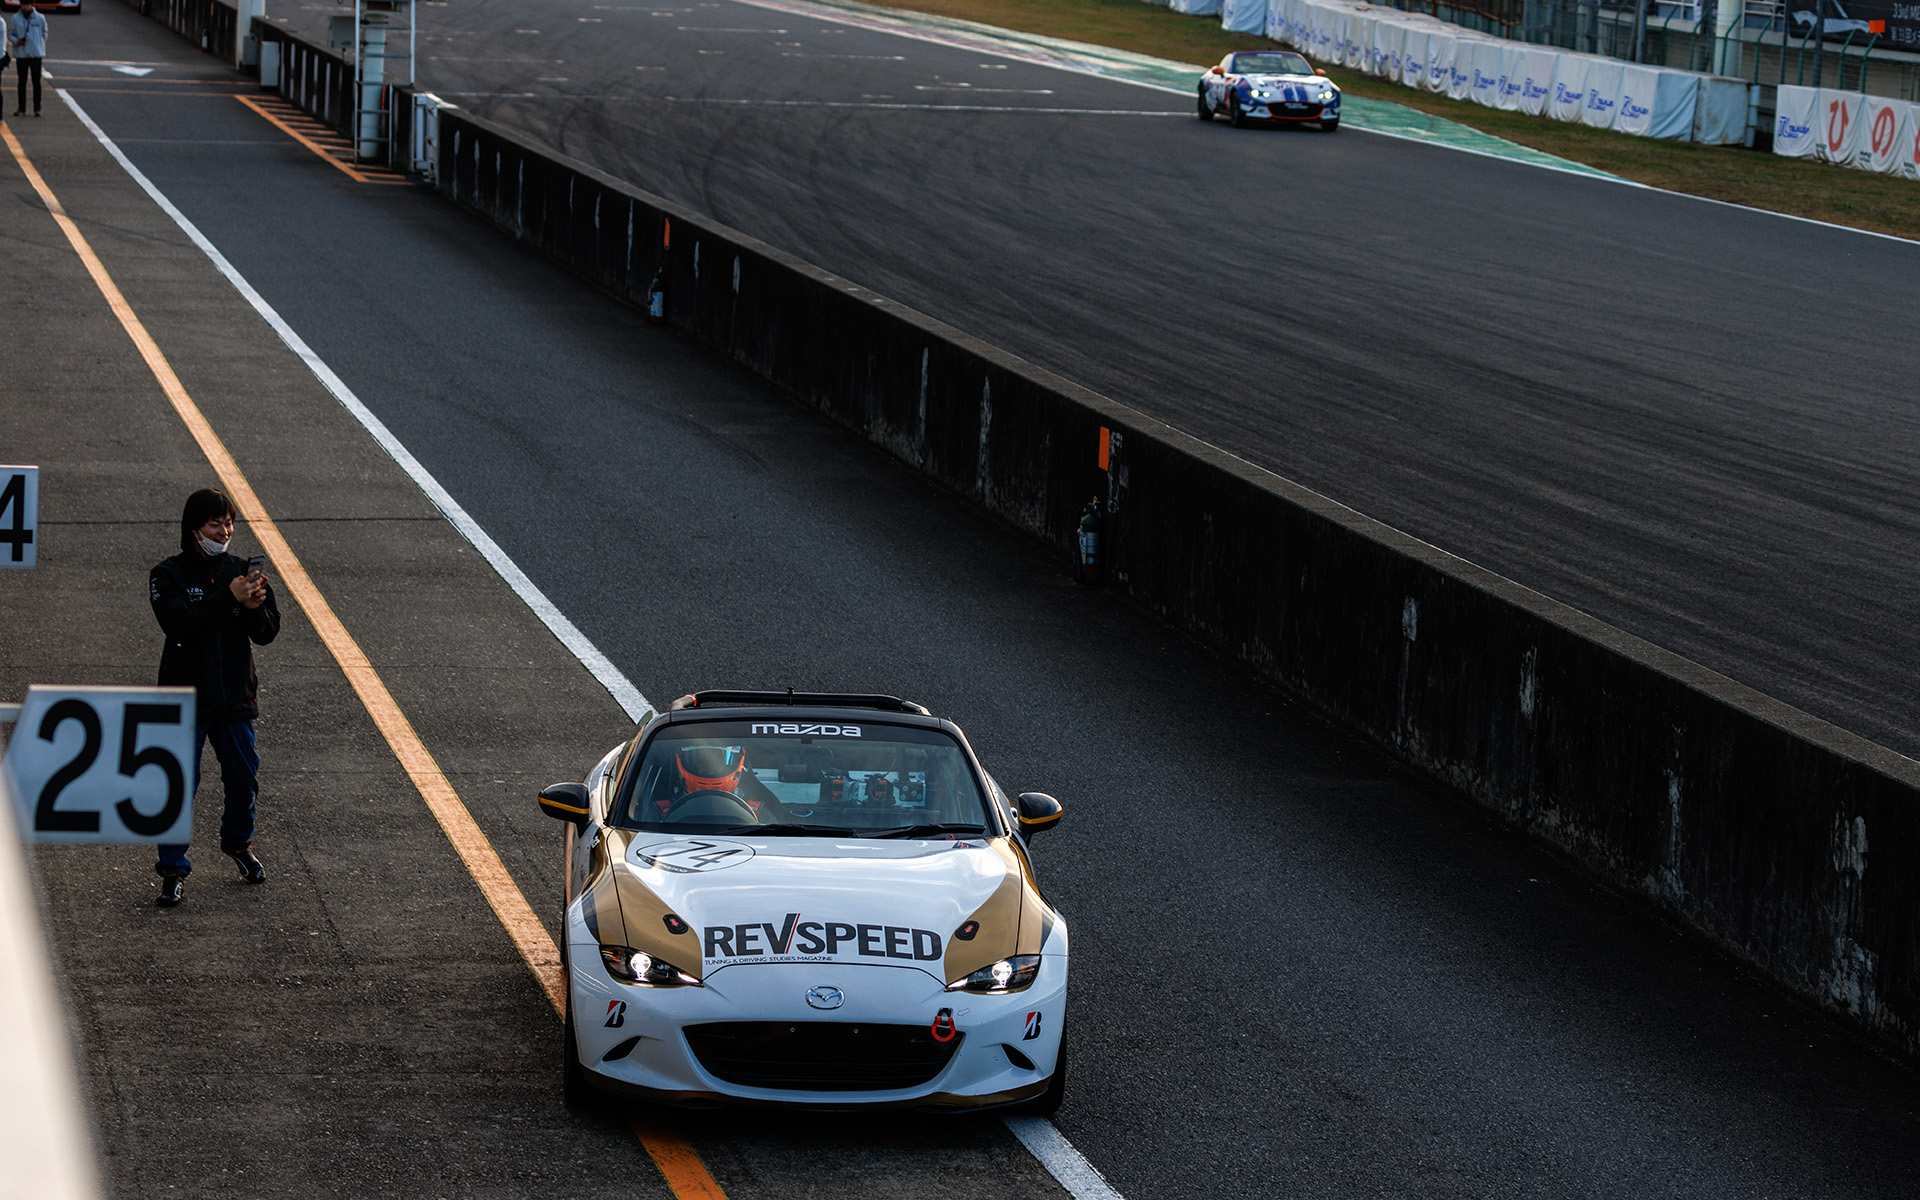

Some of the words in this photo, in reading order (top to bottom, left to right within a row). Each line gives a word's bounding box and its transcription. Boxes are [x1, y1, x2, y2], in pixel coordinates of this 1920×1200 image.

[0, 474, 33, 562] 4
[35, 697, 185, 836] 25
[650, 841, 743, 868] 74
